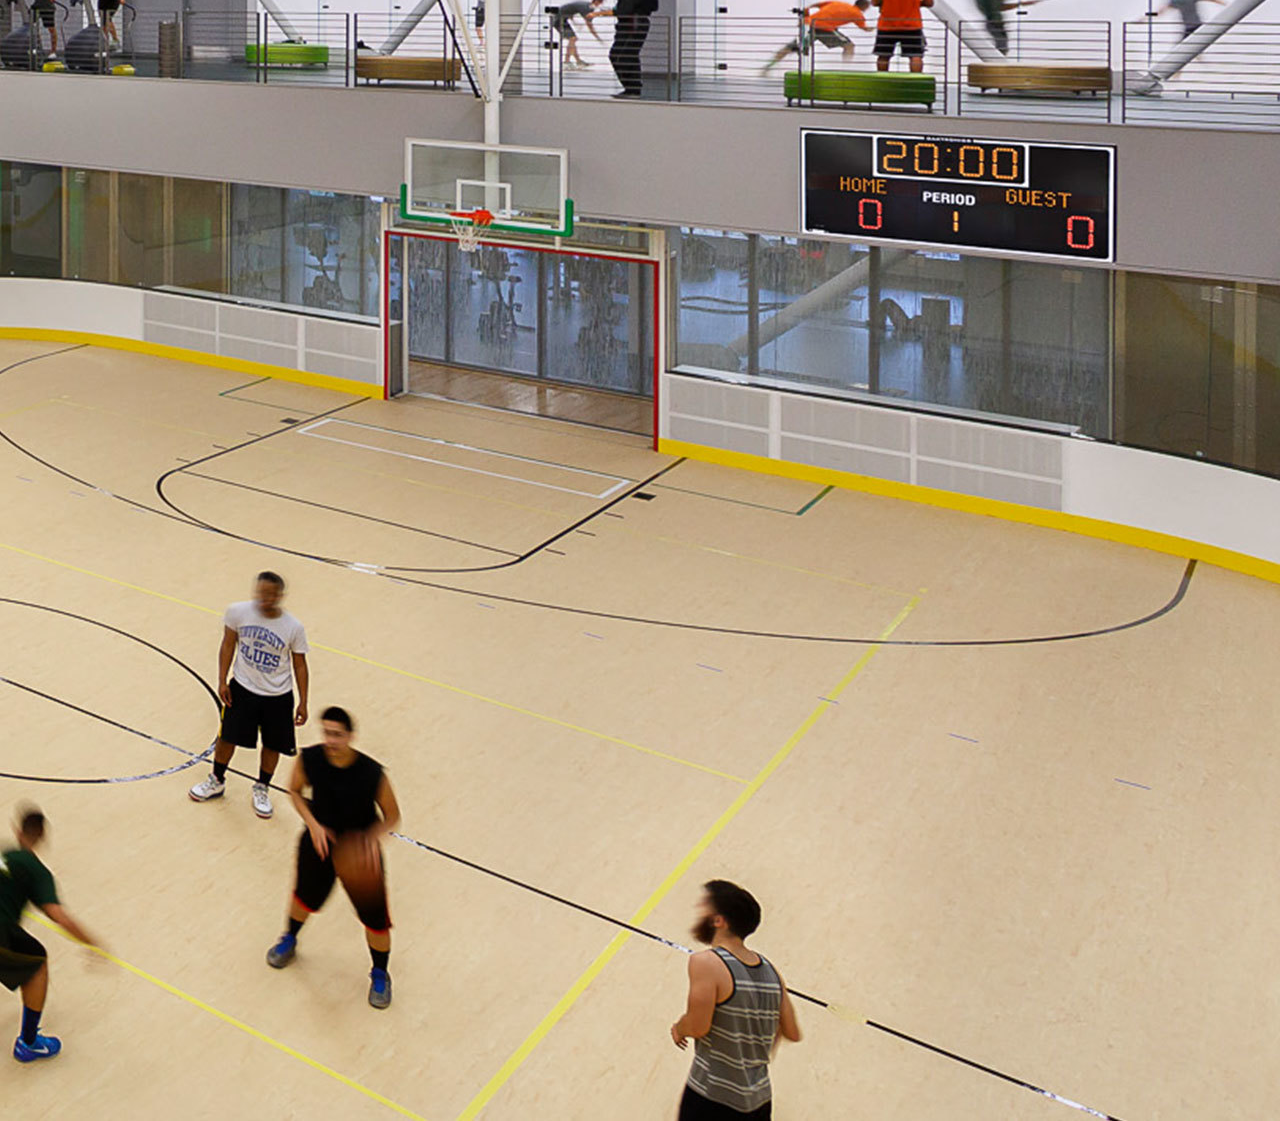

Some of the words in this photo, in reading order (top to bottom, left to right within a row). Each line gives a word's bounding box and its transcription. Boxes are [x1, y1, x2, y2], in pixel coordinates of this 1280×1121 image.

[882, 140, 1019, 181] 20:00
[839, 176, 888, 195] HOME
[922, 190, 976, 206] PERIOD
[1005, 188, 1072, 209] GUEST
[858, 197, 883, 230] 0
[1066, 215, 1095, 250] 0
